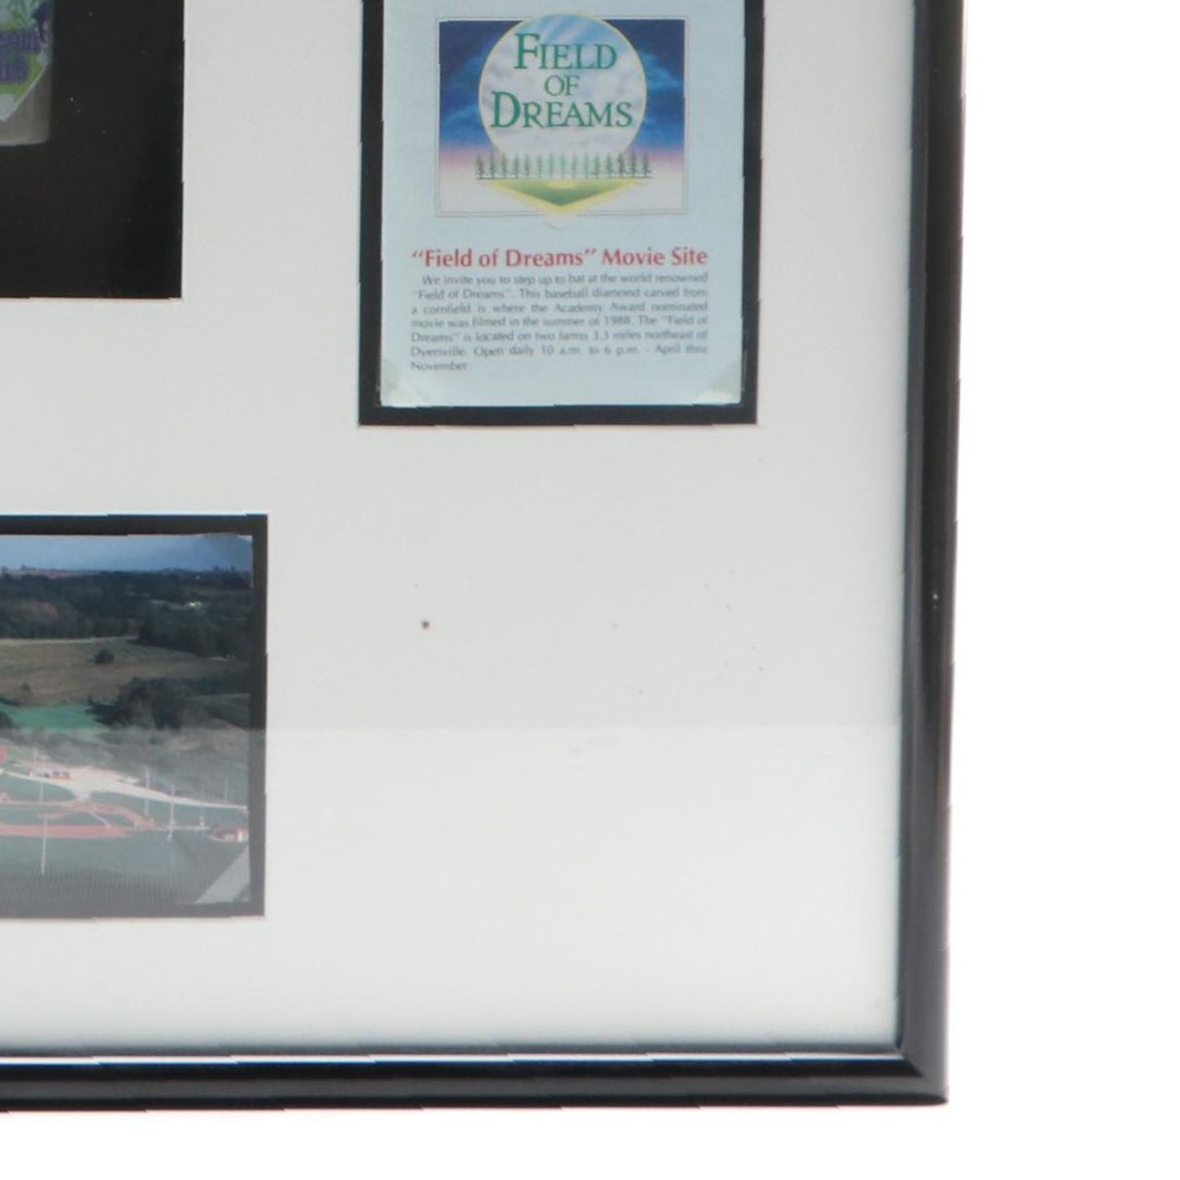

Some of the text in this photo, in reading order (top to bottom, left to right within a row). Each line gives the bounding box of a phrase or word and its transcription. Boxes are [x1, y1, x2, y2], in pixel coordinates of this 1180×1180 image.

[514, 33, 618, 70] FIELD
[543, 74, 580, 97] OF
[490, 91, 633, 129] DREAMS
[411, 246, 709, 268] “Field of Dreams” Movie Site
[422, 275, 441, 285] We
[443, 275, 473, 285] invite
[476, 276, 497, 286] you
[499, 275, 511, 285] to
[514, 275, 536, 286] step
[539, 276, 553, 286] up
[568, 273, 585, 283] bat
[599, 273, 617, 283] the
[620, 272, 653, 283] world
[655, 271, 708, 283] renowned
[448, 288, 460, 299] of
[520, 288, 541, 299] This
[545, 287, 589, 298] baseball
[592, 286, 641, 298] diamond
[644, 287, 680, 298] carved
[684, 287, 708, 297] from
[423, 303, 471, 314] cornfield
[492, 304, 525, 313] where
[531, 304, 549, 313] the
[555, 303, 602, 315] Academy
[610, 302, 645, 312] Award
[651, 301, 708, 312] nominated
[410, 319, 445, 328] movie
[447, 320, 469, 328] was
[472, 316, 506, 327] filmed
[522, 317, 539, 327] the
[475, 331, 514, 341] located
[474, 346, 504, 358] Open
[509, 345, 535, 357] daily
